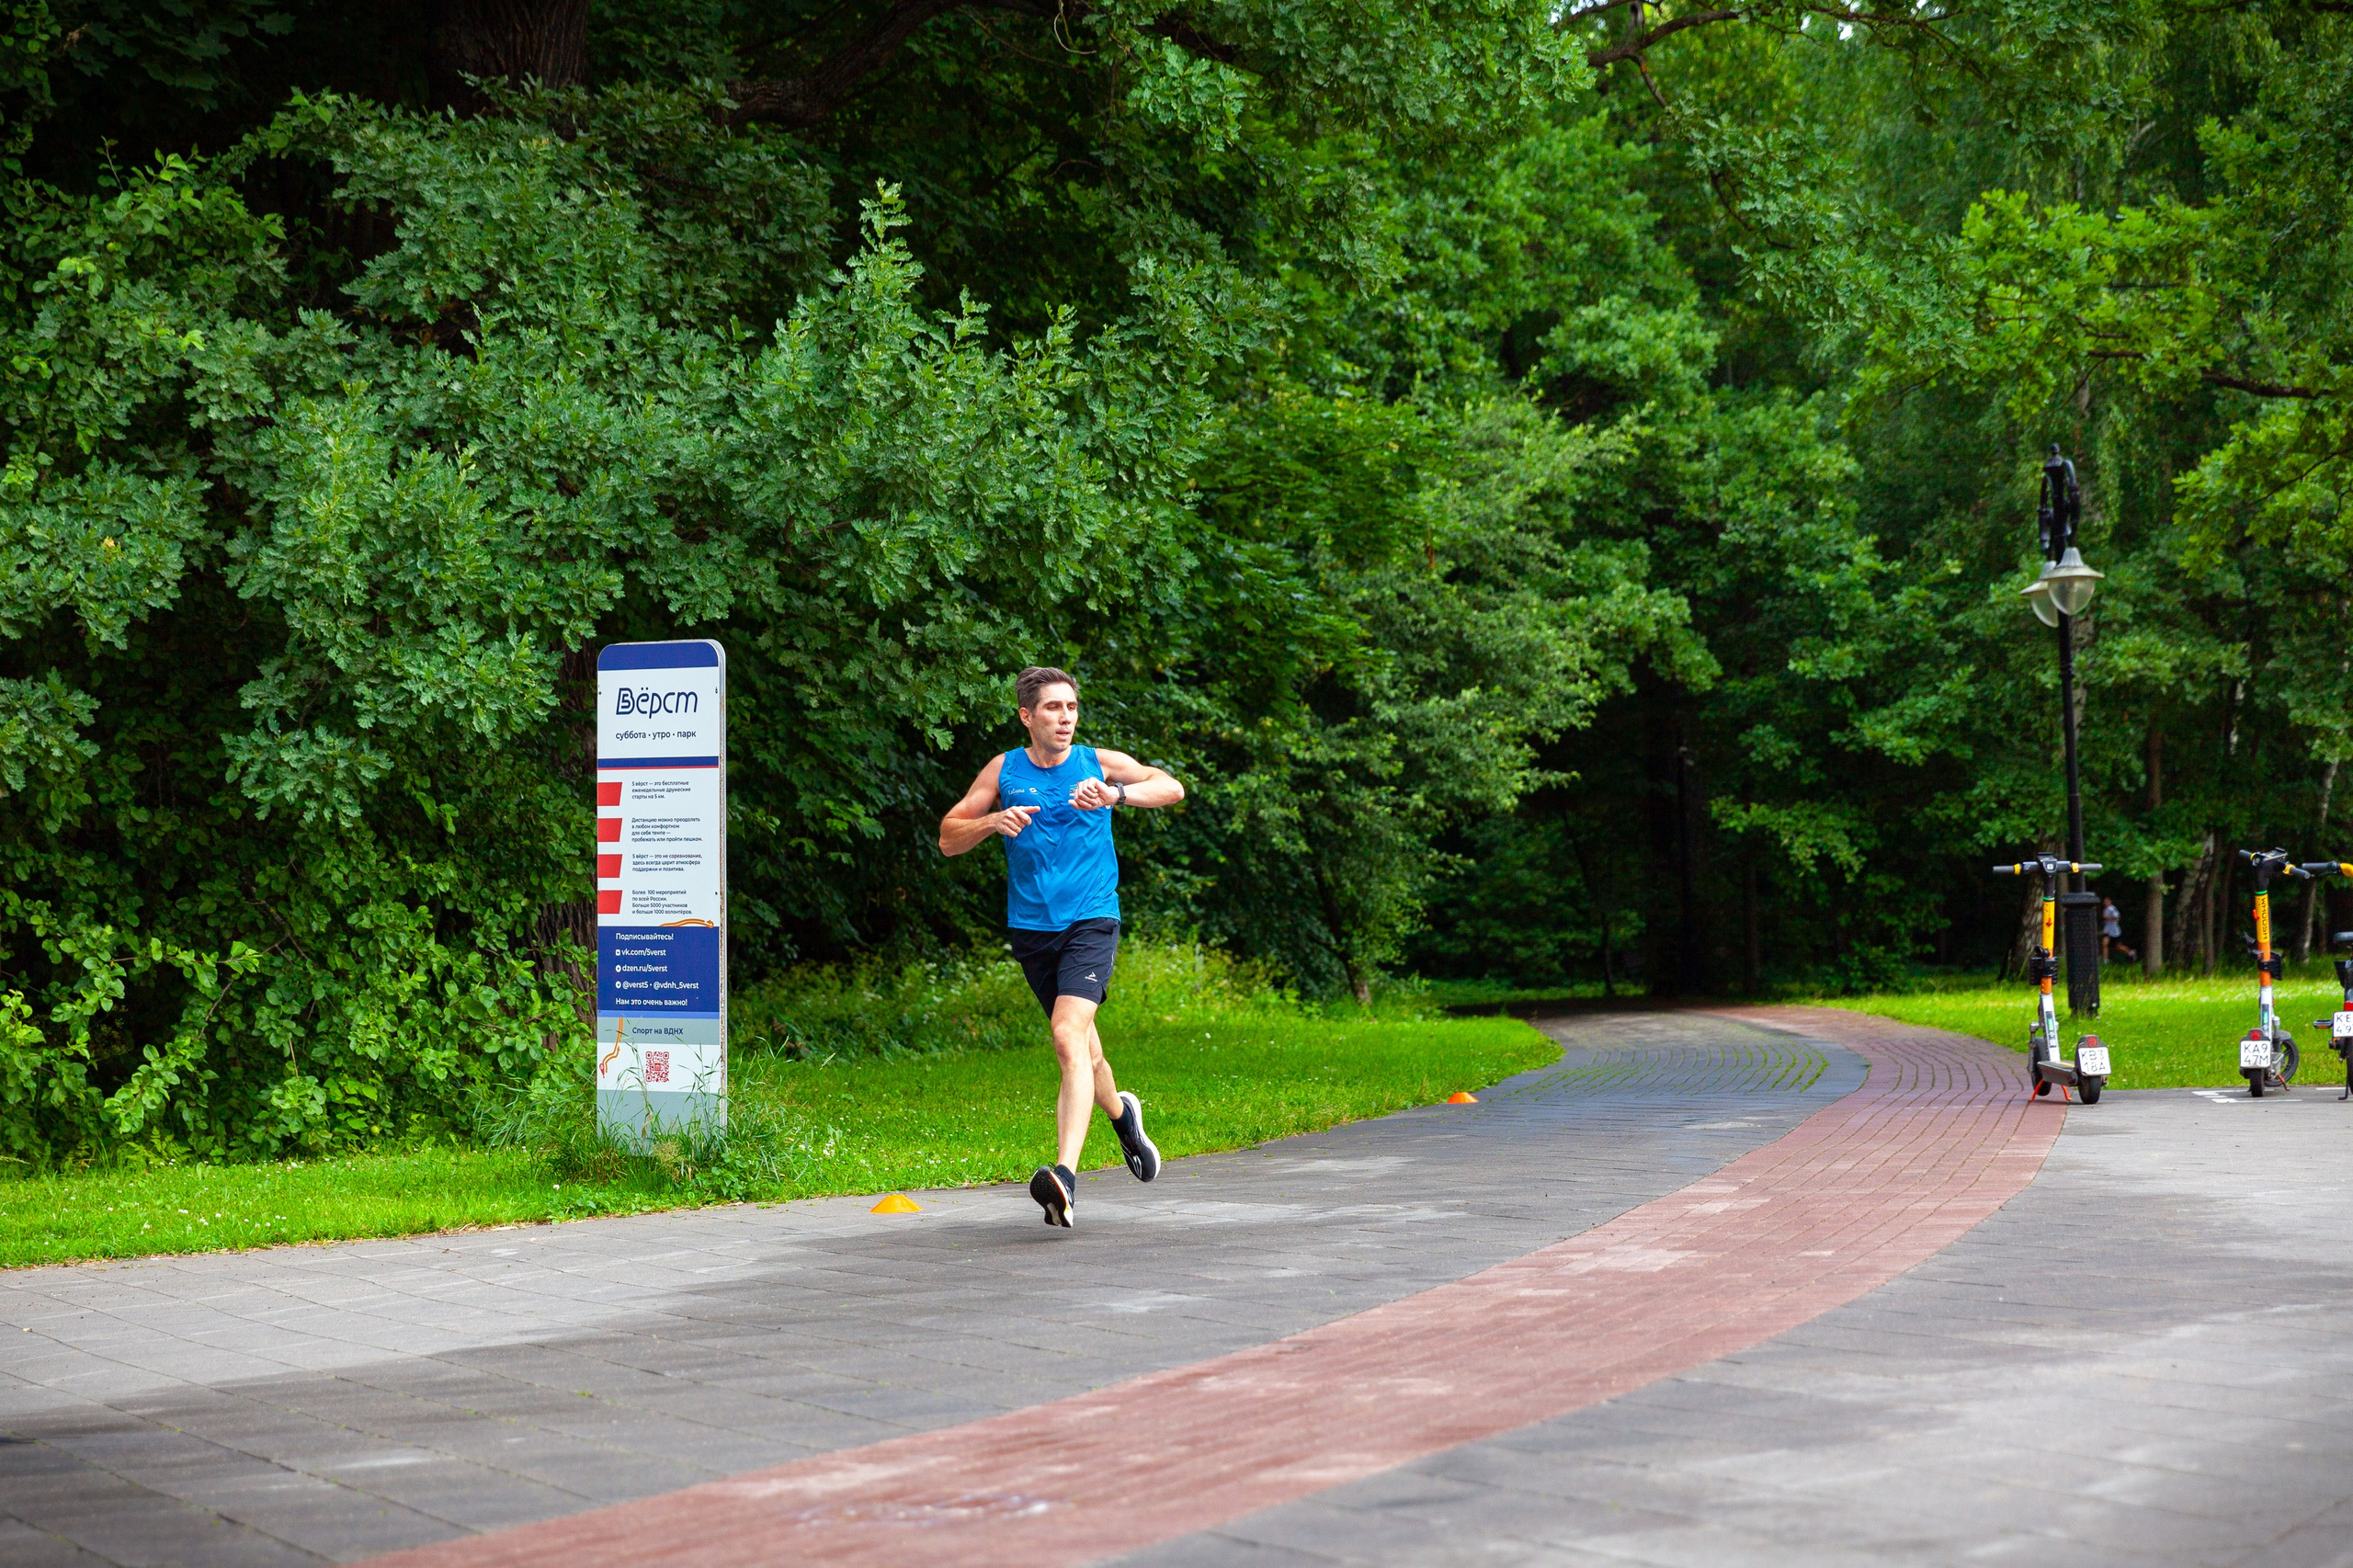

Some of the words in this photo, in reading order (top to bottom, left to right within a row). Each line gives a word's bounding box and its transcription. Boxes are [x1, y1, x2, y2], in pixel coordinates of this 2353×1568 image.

[616, 731, 646, 741] суббота
[653, 731, 671, 740] утро
[677, 731, 696, 739] парк
[616, 933, 674, 941] Подписывайтесь!
[621, 948, 666, 956] vk.com/5verst
[622, 964, 667, 972] dzen.ru/5verst
[622, 981, 648, 989] @verst5
[654, 982, 699, 990] @vdnh_5verst
